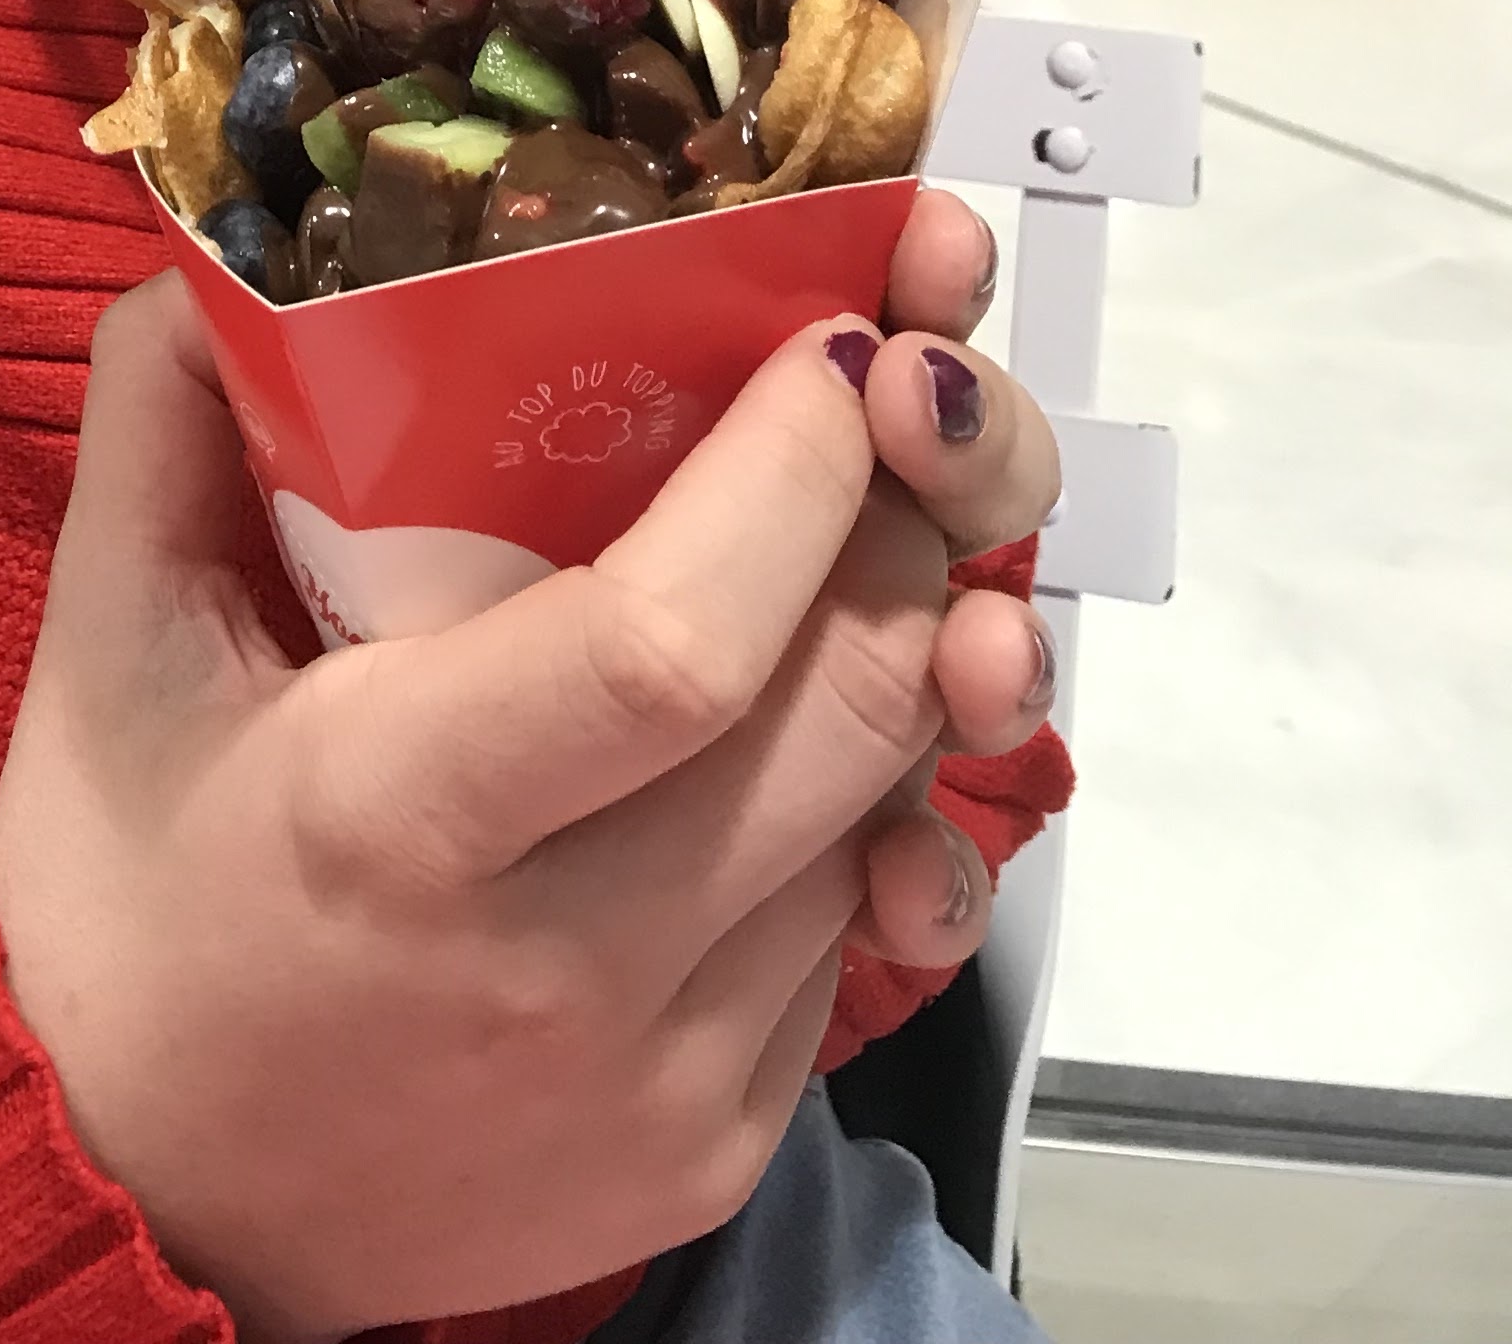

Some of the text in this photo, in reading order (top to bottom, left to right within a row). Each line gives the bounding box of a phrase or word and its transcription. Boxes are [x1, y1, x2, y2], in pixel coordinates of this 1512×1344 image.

[506, 382, 555, 425] TOP
[572, 360, 608, 393] DU
[622, 362, 677, 450] TOPPING
